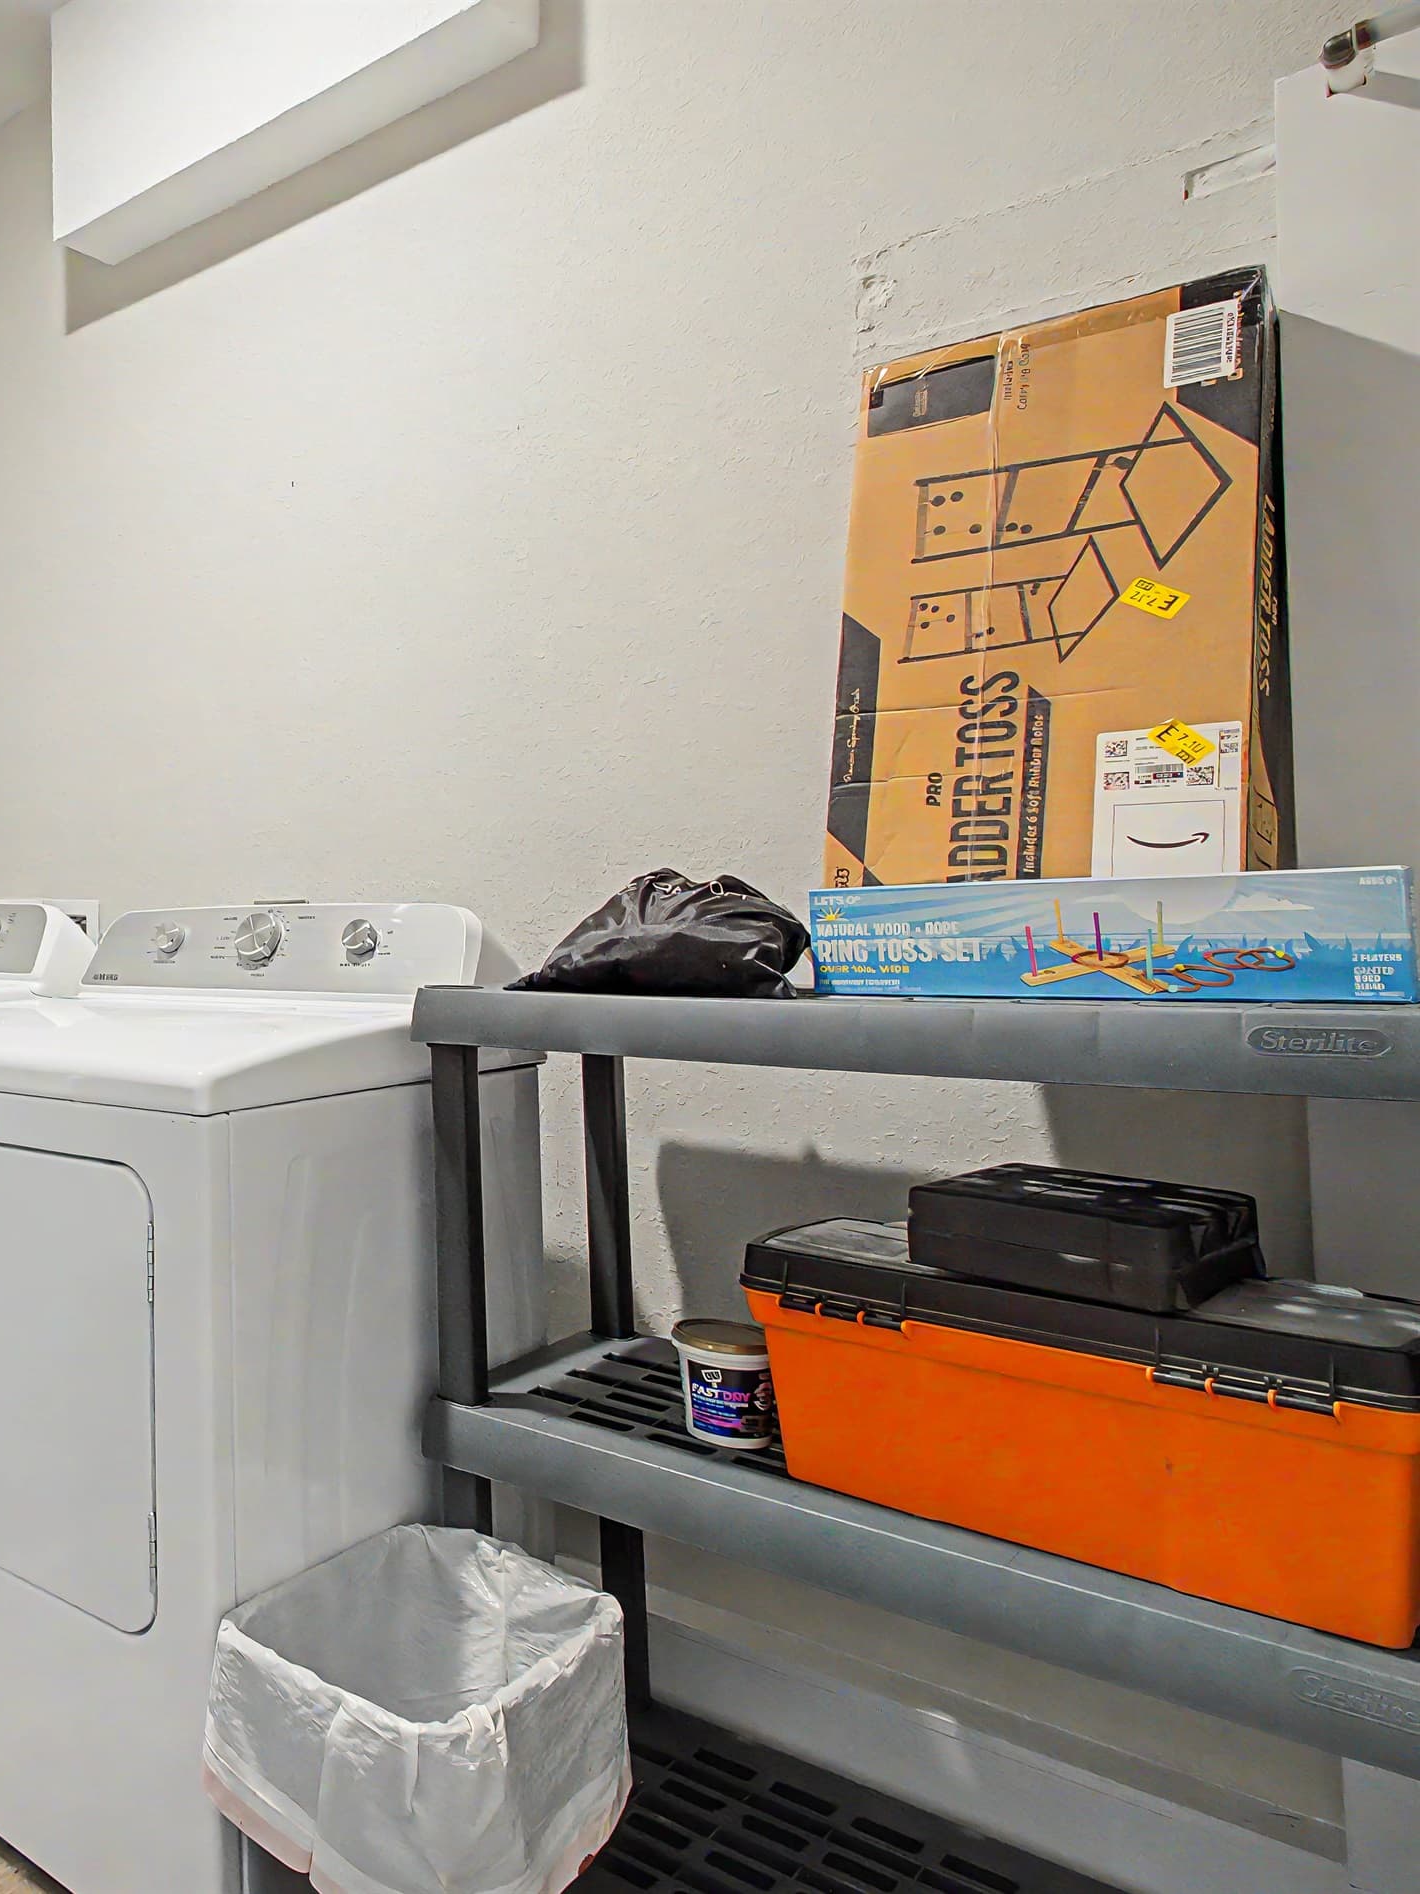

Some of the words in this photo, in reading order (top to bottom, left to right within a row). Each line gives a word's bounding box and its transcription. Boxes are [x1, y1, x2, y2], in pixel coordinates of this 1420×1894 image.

[1260, 494, 1276, 613] LADDER
[1157, 594, 1180, 611] E
[1258, 614, 1272, 697] TOSS
[955, 671, 1020, 768] TOSS
[1155, 723, 1180, 743] E
[925, 772, 944, 807] PRO
[946, 771, 1015, 883] ADDER
[816, 923, 871, 937] NATURAL
[873, 922, 911, 937] WOOD
[817, 939, 870, 963] RING
[875, 938, 934, 963] TOSS
[939, 937, 982, 963] SET
[1360, 953, 1403, 963] PLAYERS
[819, 964, 850, 974] OVER
[879, 963, 910, 974] WIDE
[1260, 1029, 1377, 1052] Sterilite
[691, 1382, 723, 1399] FAST
[723, 1390, 751, 1403] DRY
